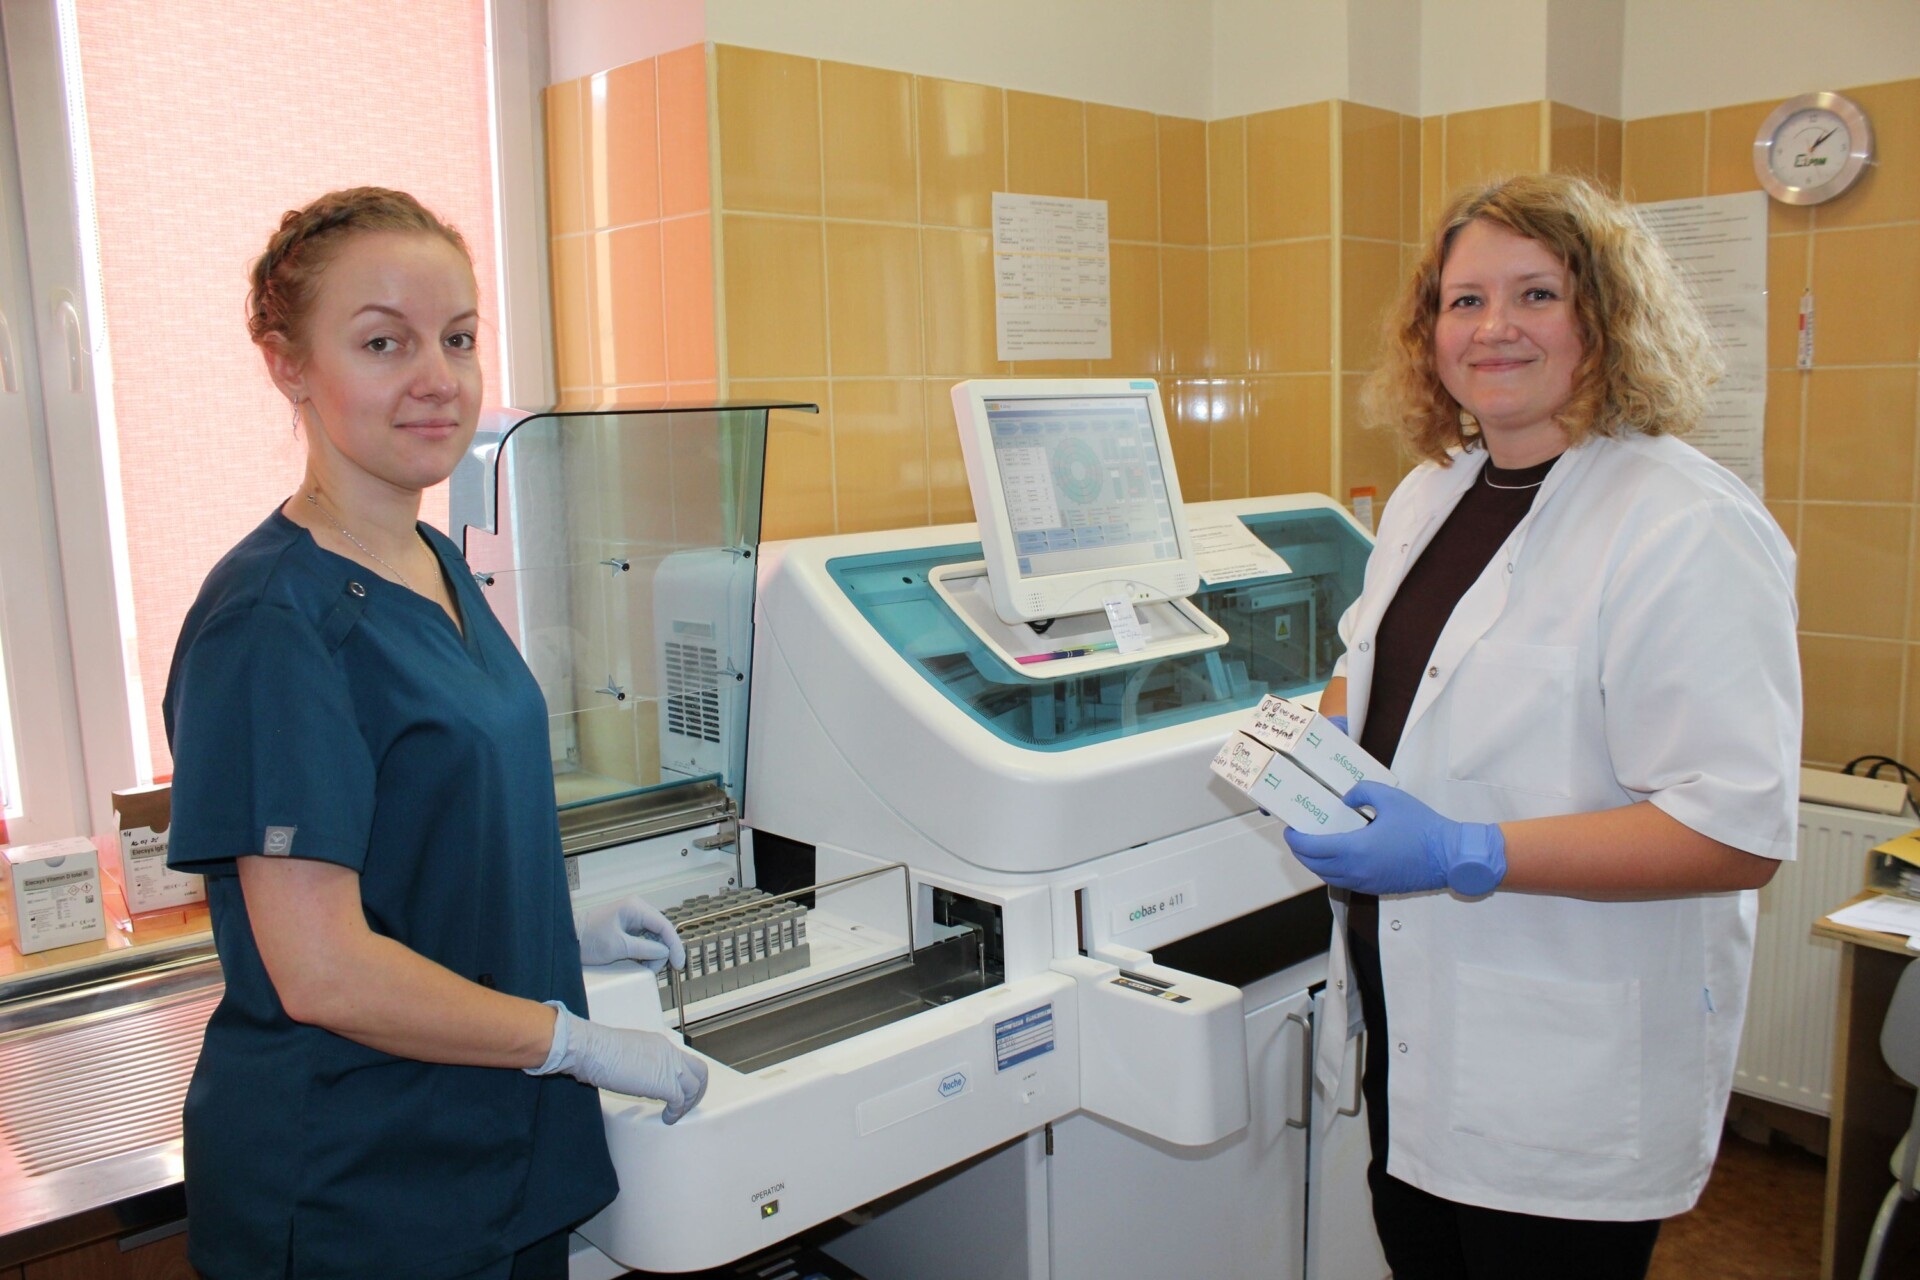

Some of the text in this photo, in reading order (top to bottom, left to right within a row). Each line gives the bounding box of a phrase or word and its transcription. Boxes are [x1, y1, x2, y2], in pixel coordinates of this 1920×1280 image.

[1334, 753, 1364, 782] Elecsys
[1295, 794, 1329, 825] Elecsys
[1129, 893, 1183, 921] cobas e 411
[943, 1079, 962, 1091] Roche
[751, 1183, 784, 1202] OPERATION
